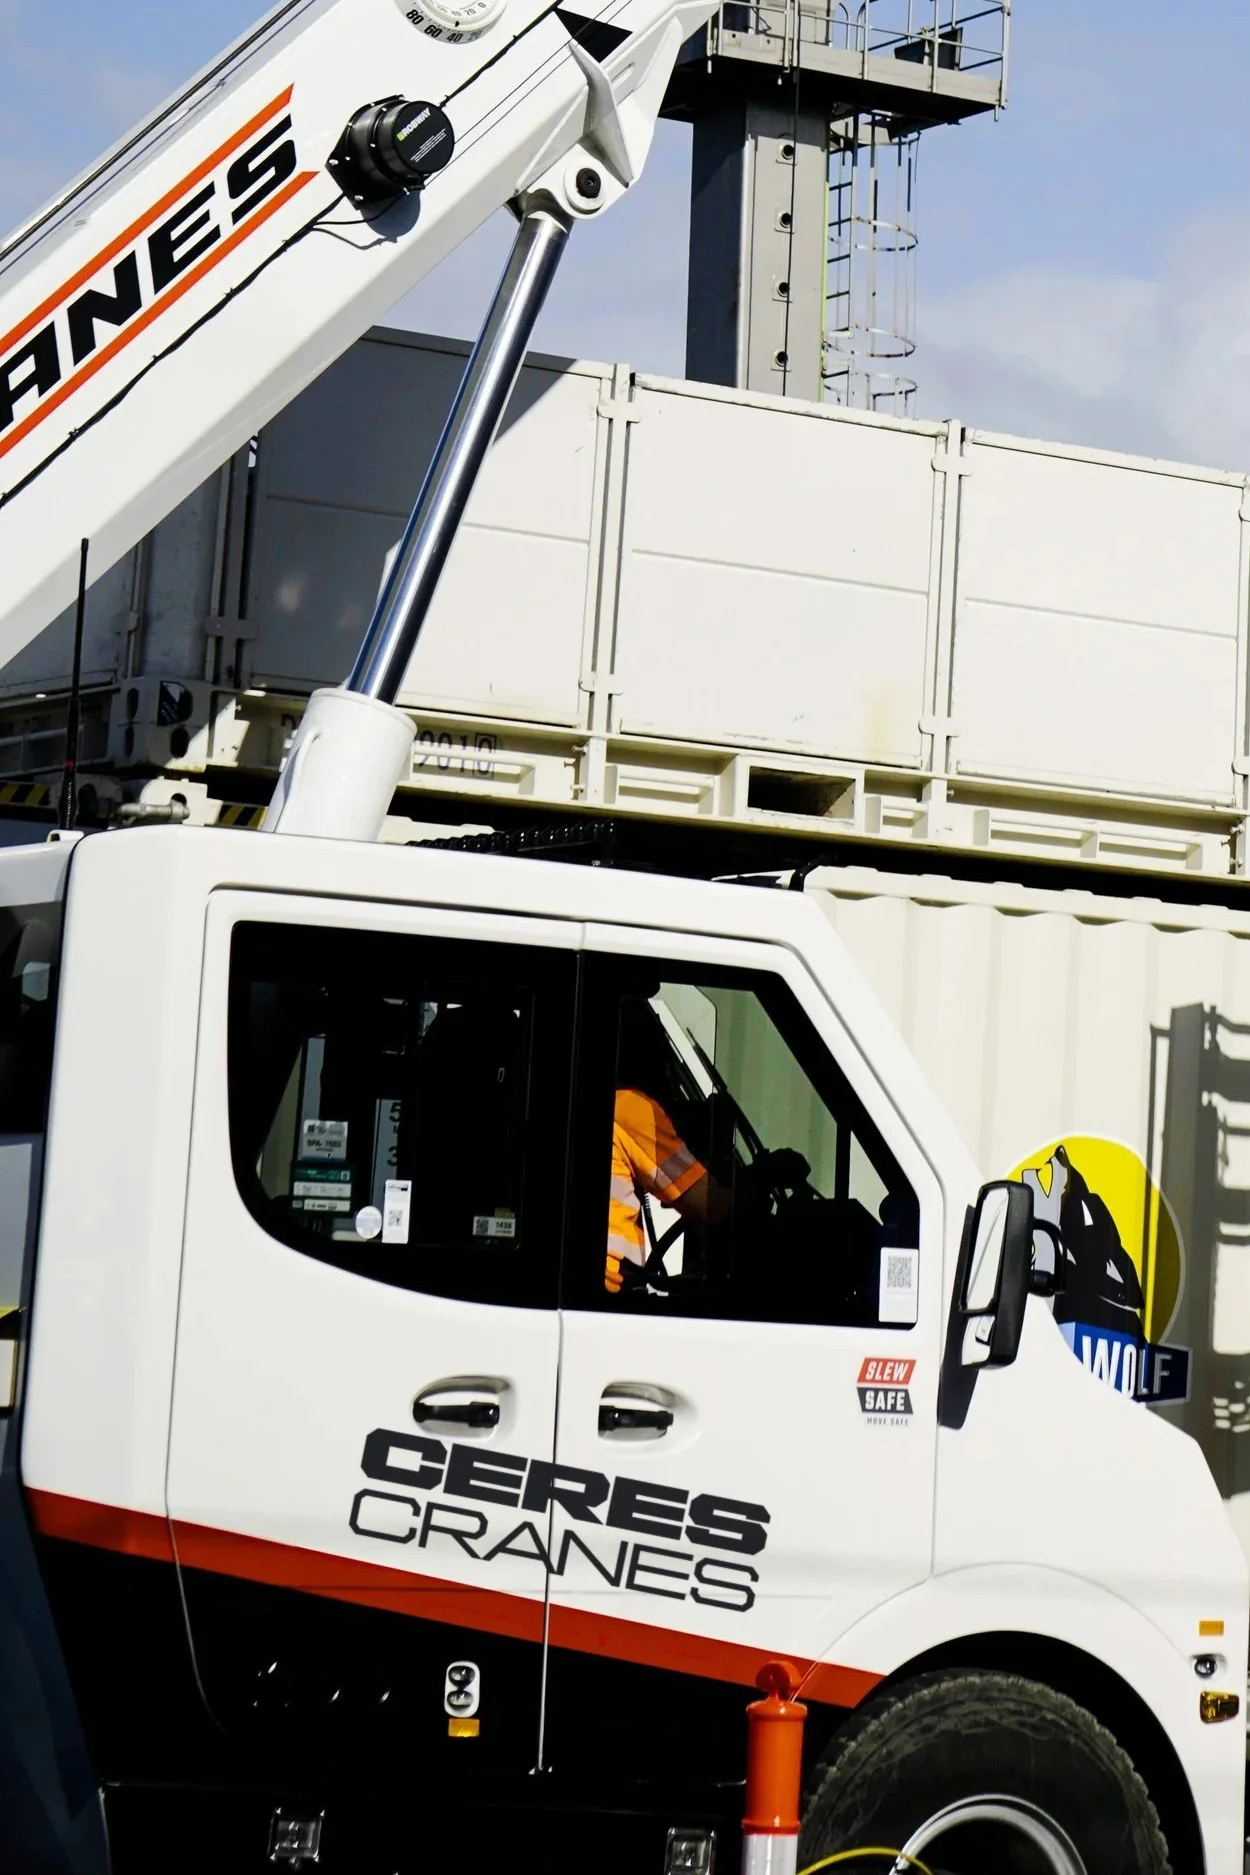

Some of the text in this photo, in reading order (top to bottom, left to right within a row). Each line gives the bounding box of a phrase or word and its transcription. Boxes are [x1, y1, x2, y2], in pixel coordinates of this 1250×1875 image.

[406, 9, 424, 25] 80
[424, 25, 442, 38] 60
[446, 33, 463, 43] 40
[401, 107, 431, 137] ROBWAY
[865, 1360, 909, 1382] SLEW
[1081, 1335, 1172, 1400] WOLF
[865, 1389, 906, 1412] SAFE
[360, 1428, 771, 1556] CERES
[349, 1488, 760, 1613] CRANES
